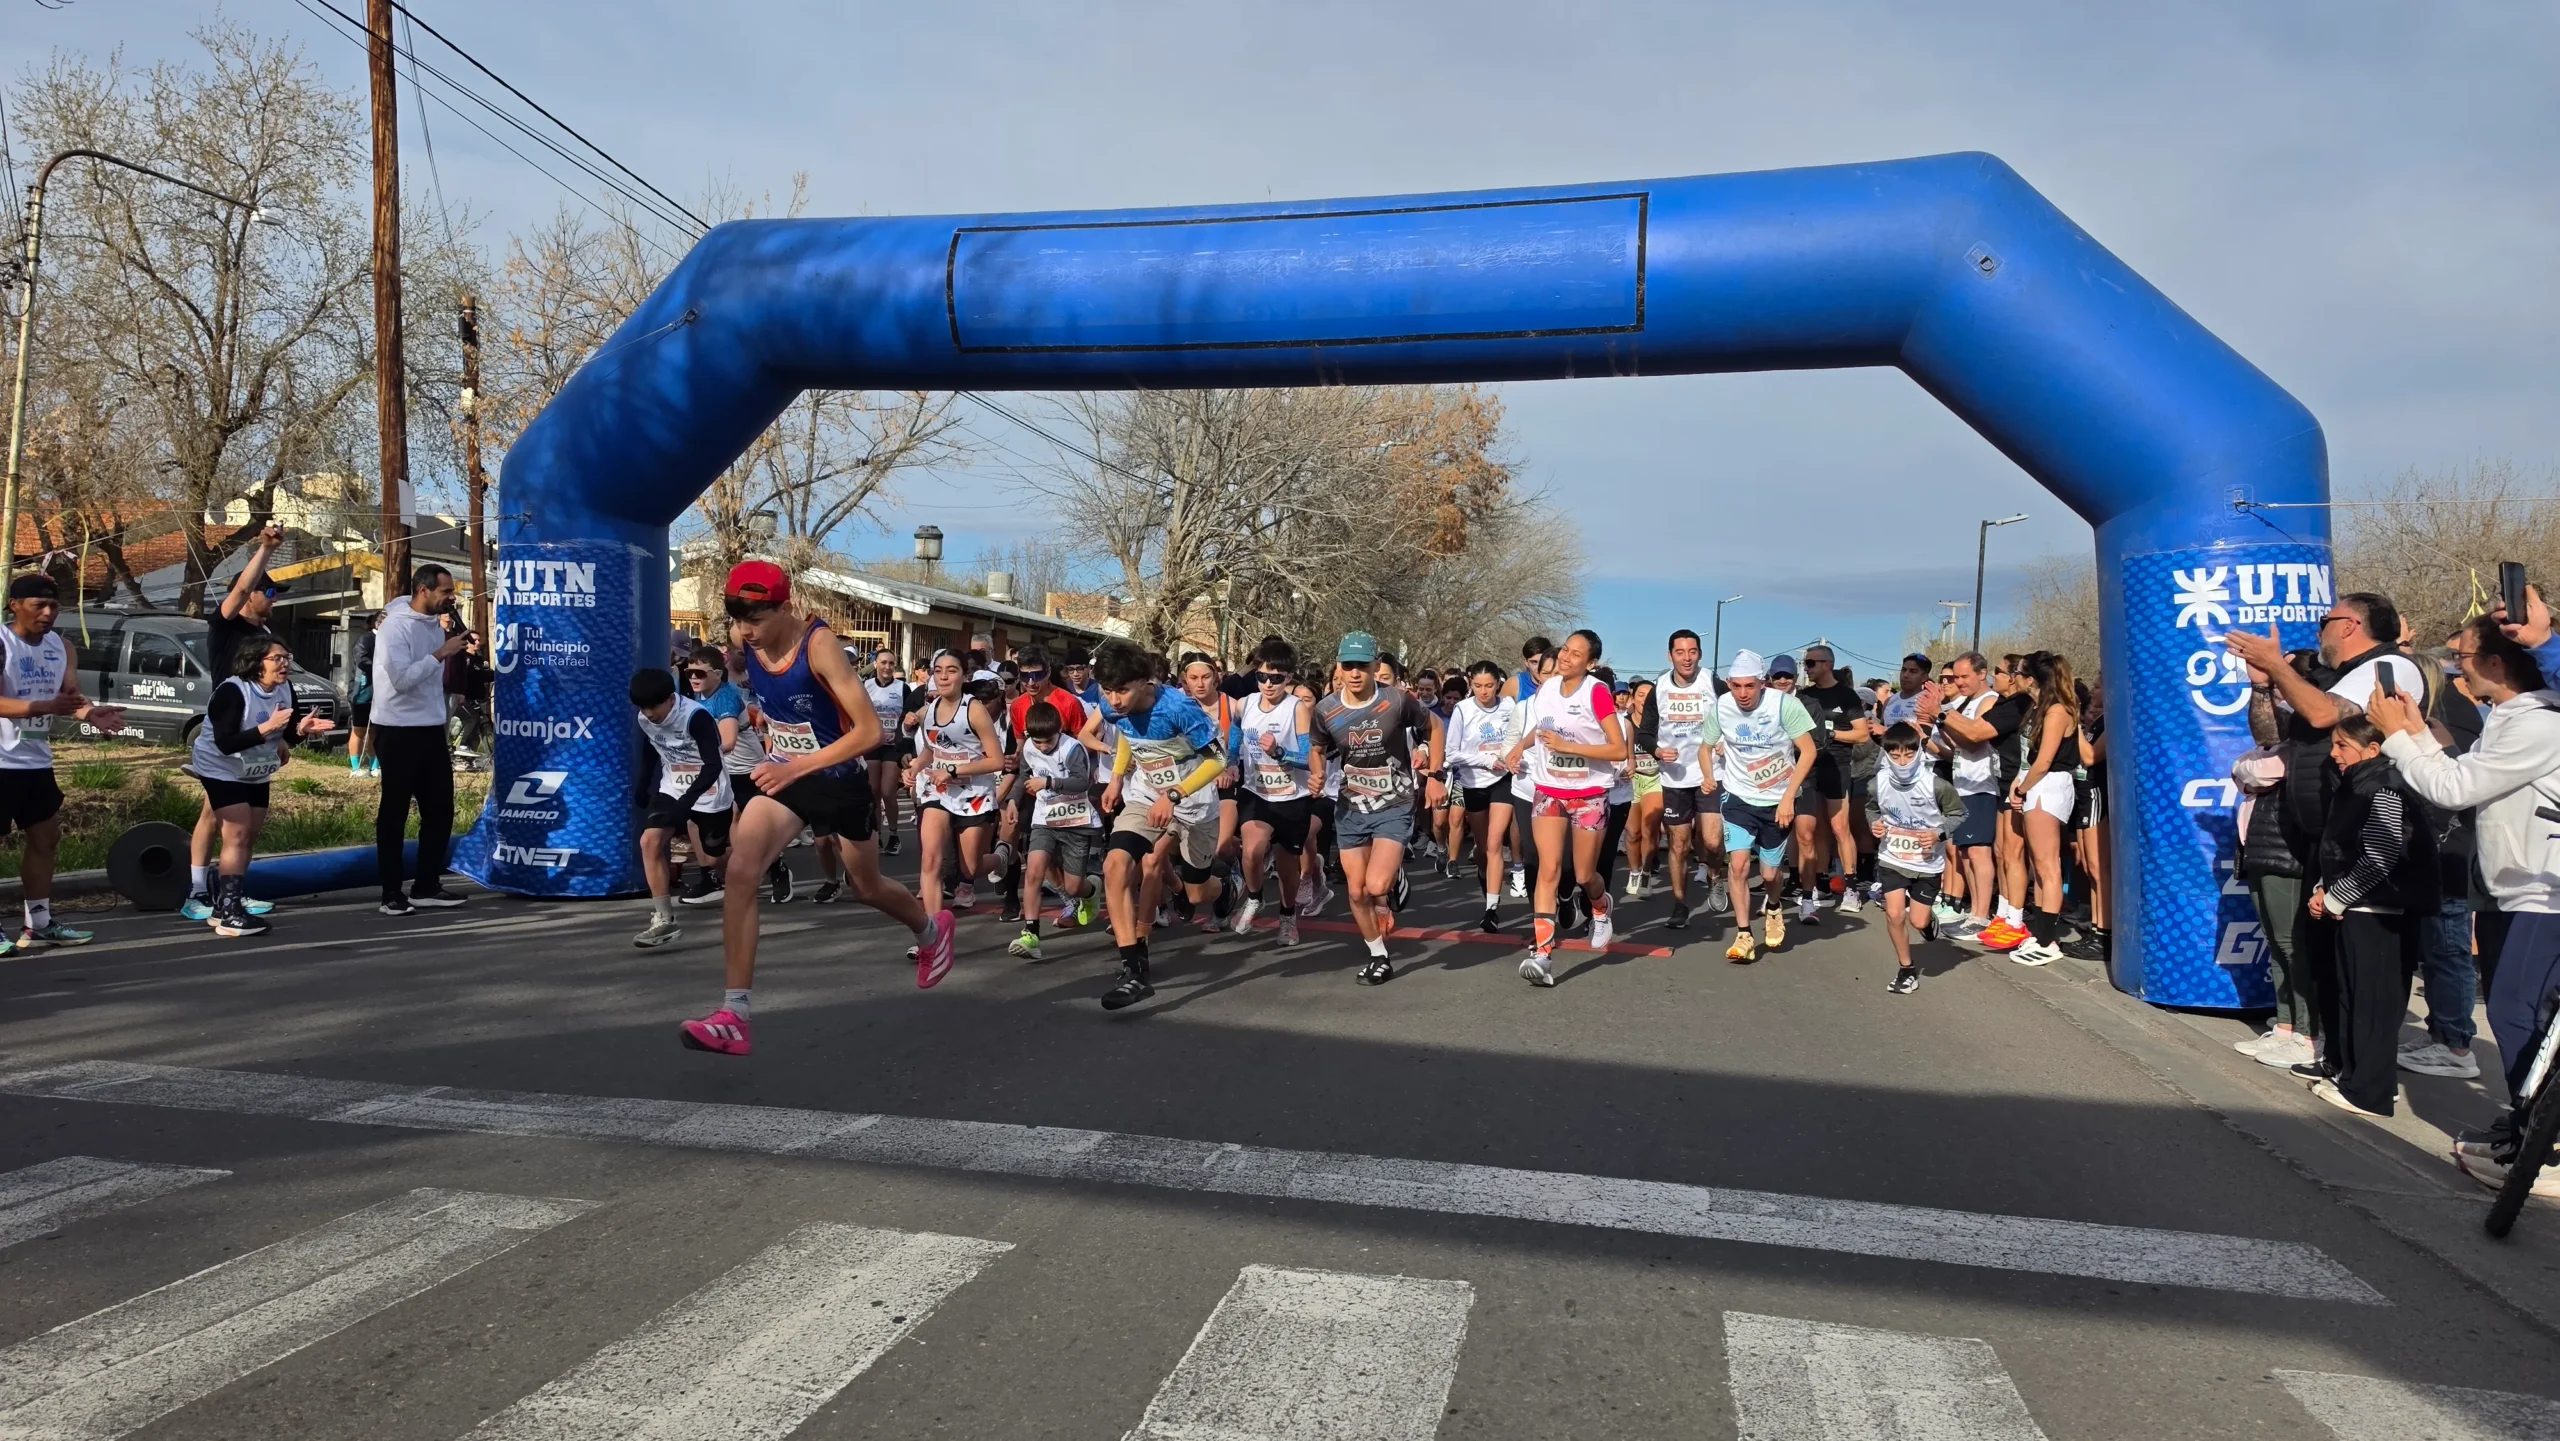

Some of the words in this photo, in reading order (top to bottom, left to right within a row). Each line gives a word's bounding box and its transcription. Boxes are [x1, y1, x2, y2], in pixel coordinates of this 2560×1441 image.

[513, 560, 596, 593] UTN
[2236, 563, 2332, 604] UTN
[513, 592, 596, 608] DEPORTES
[524, 626, 543, 639] Tu!
[524, 640, 591, 655] Municipio
[523, 655, 546, 666] San
[548, 656, 590, 667] Rafael
[1669, 702, 1700, 712] 4051
[882, 719, 896, 728] 68
[1349, 729, 1383, 746] MG
[1548, 755, 1586, 768] 4070
[245, 763, 277, 777] 1036
[1754, 757, 1789, 782] 4022
[1256, 774, 1292, 786] 4043
[1350, 774, 1389, 789] 4080
[1047, 802, 1087, 818] 4065
